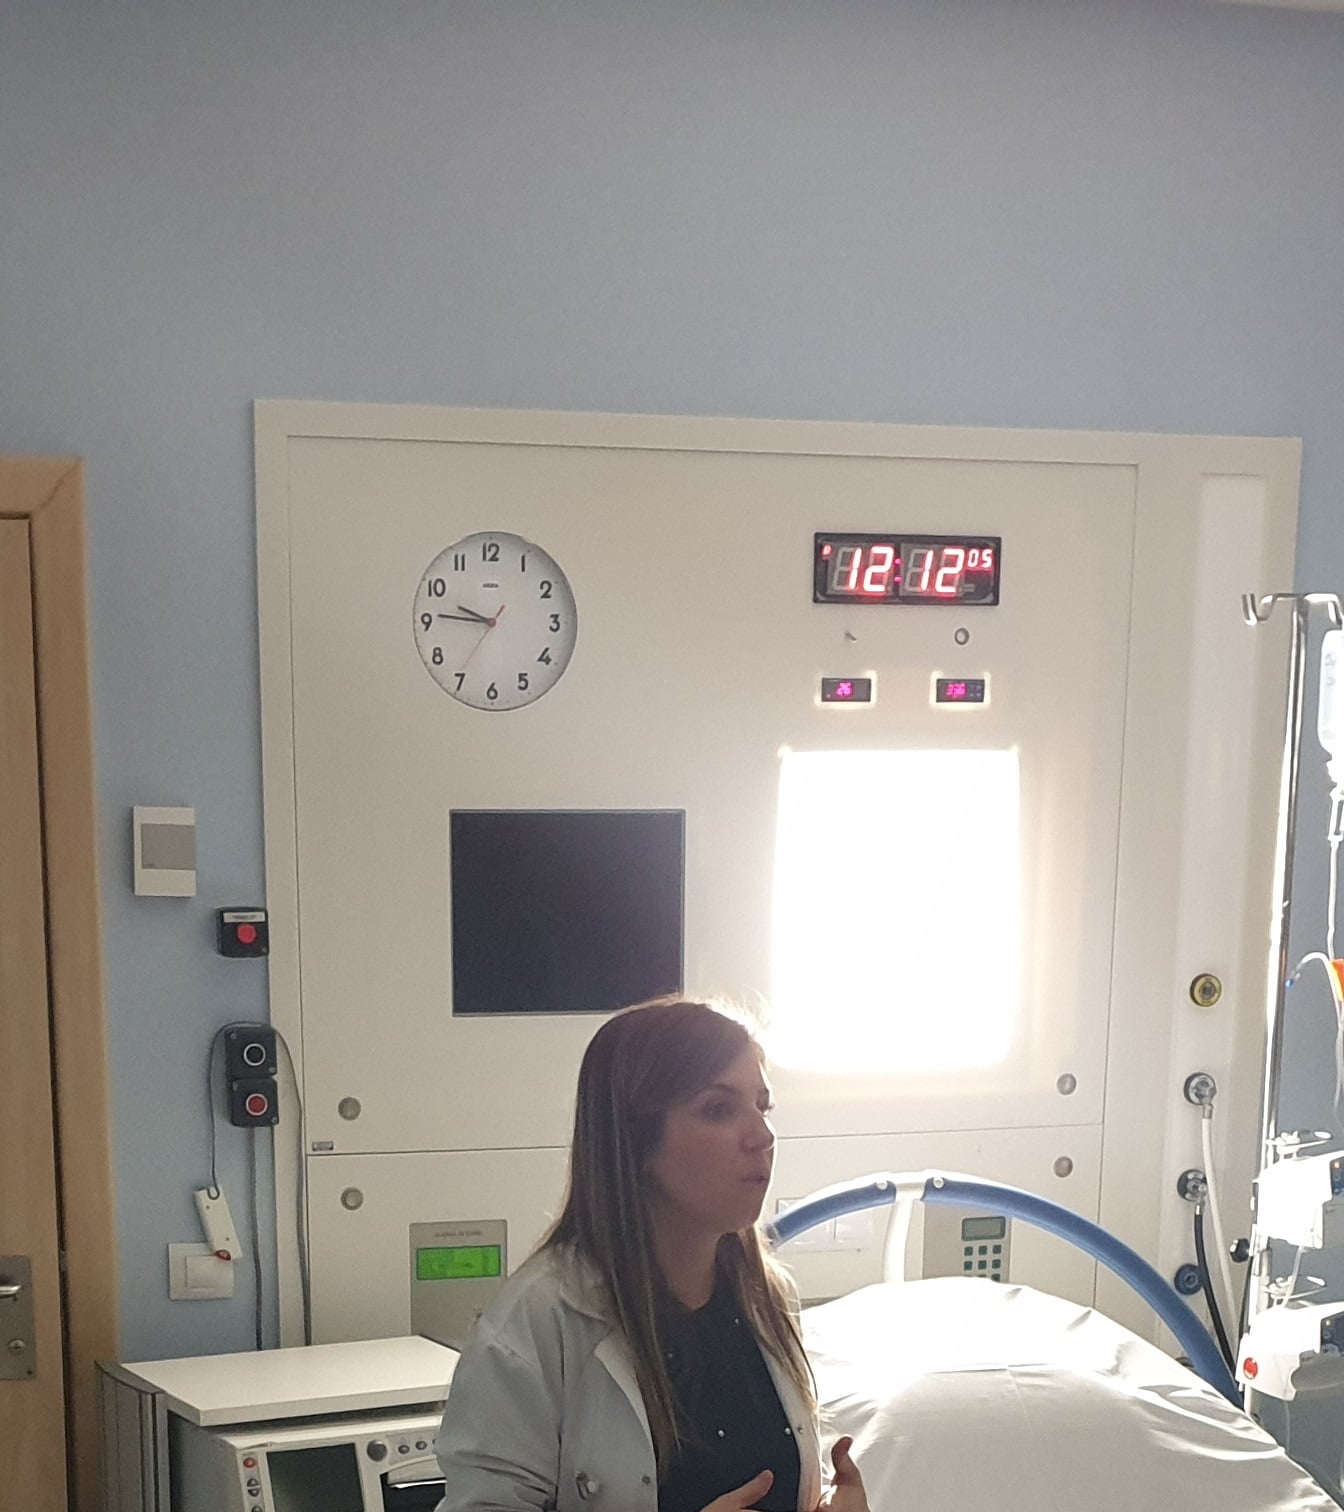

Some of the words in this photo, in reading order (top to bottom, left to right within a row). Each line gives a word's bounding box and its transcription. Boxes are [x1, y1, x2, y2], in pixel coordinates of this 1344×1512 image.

[481, 543, 500, 562] 12
[967, 548, 993, 568] 05
[454, 553, 466, 572] 11
[427, 578, 446, 598] 10
[539, 580, 553, 599] 2
[420, 612, 433, 631] 9
[548, 613, 561, 632] 3
[431, 647, 444, 665] 8
[537, 647, 553, 665] 4
[454, 673, 466, 691] 7
[486, 682, 498, 700] 6
[517, 673, 529, 690] 5
